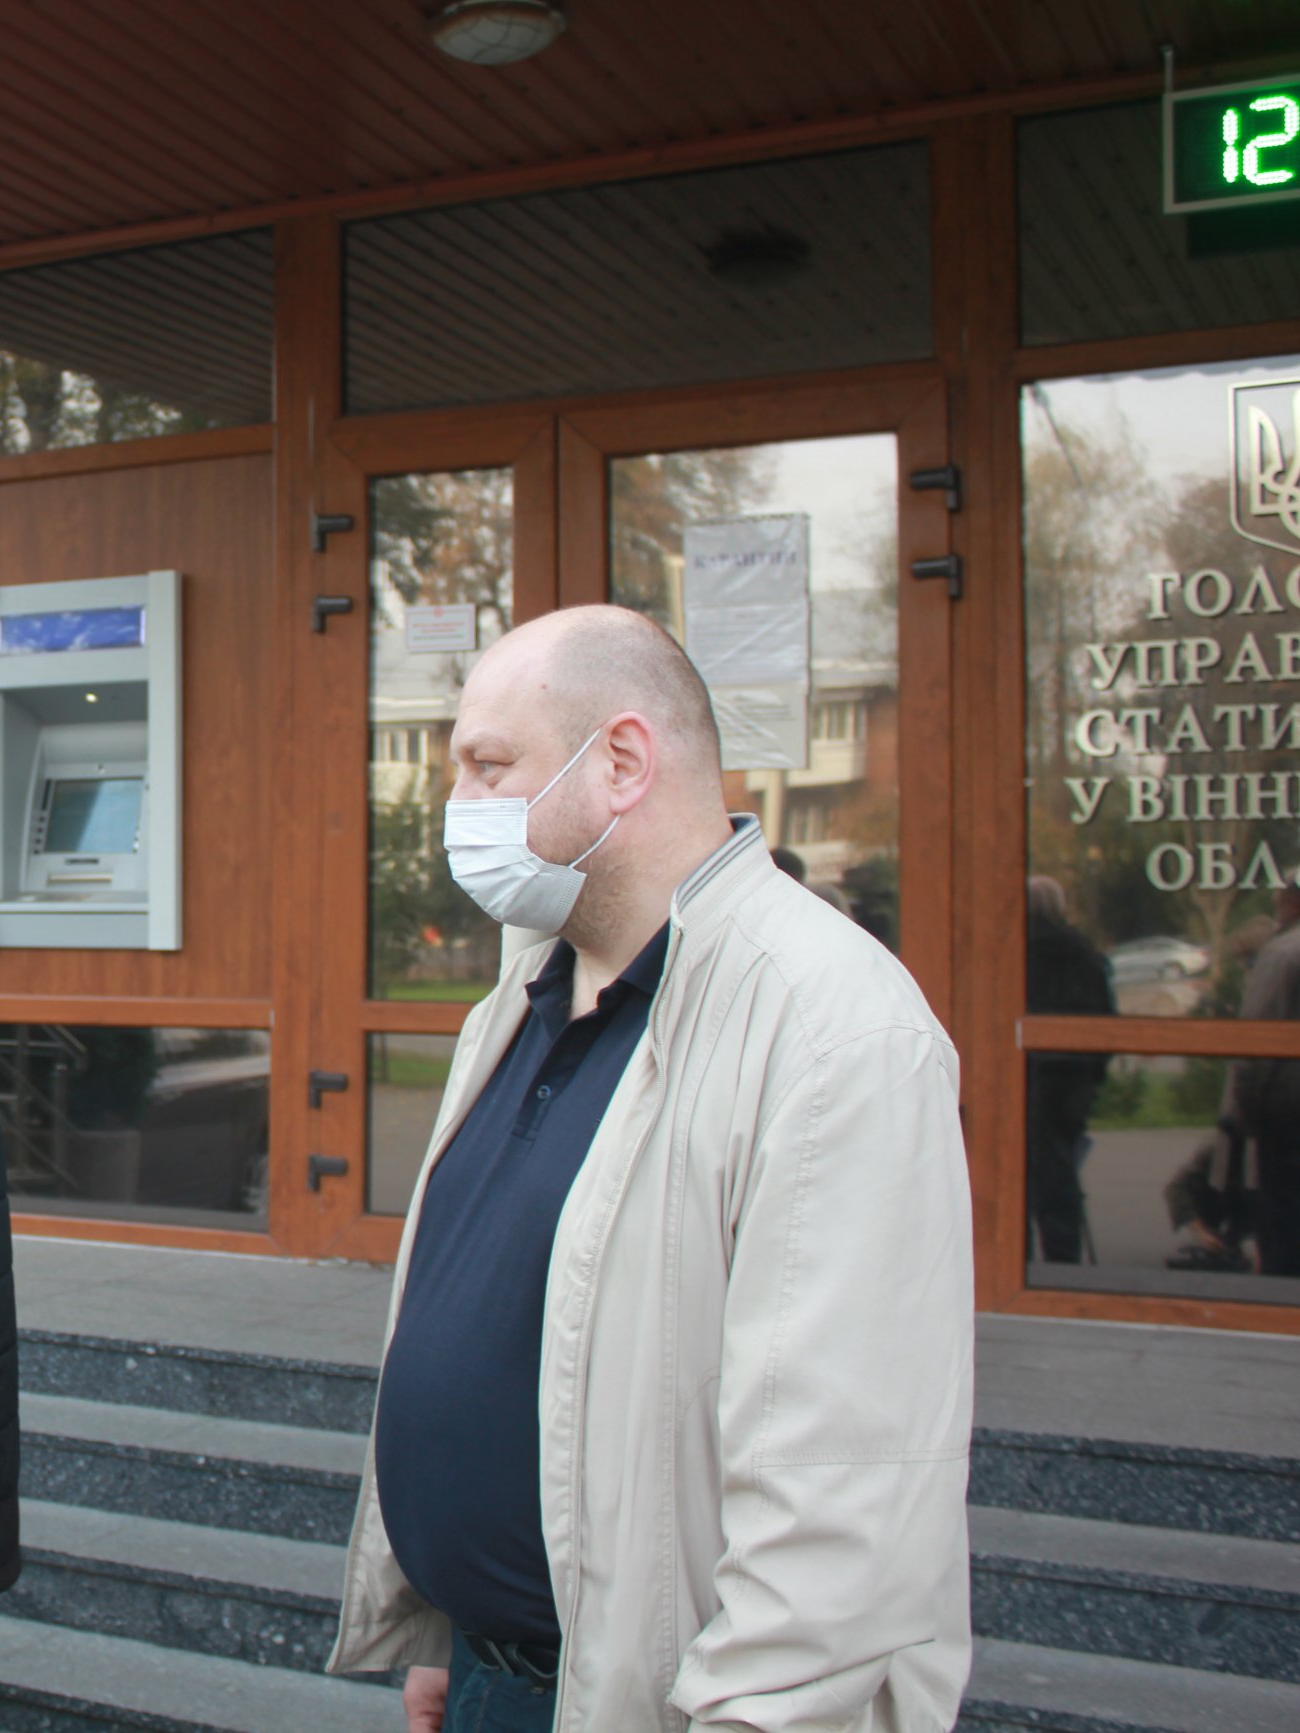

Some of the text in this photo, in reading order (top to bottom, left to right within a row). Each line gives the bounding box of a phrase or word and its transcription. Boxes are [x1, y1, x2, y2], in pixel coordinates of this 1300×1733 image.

[1222, 96, 1300, 186] 12
[1063, 771, 1300, 825] У ВІНН
[1146, 840, 1300, 892] ОБЛ
